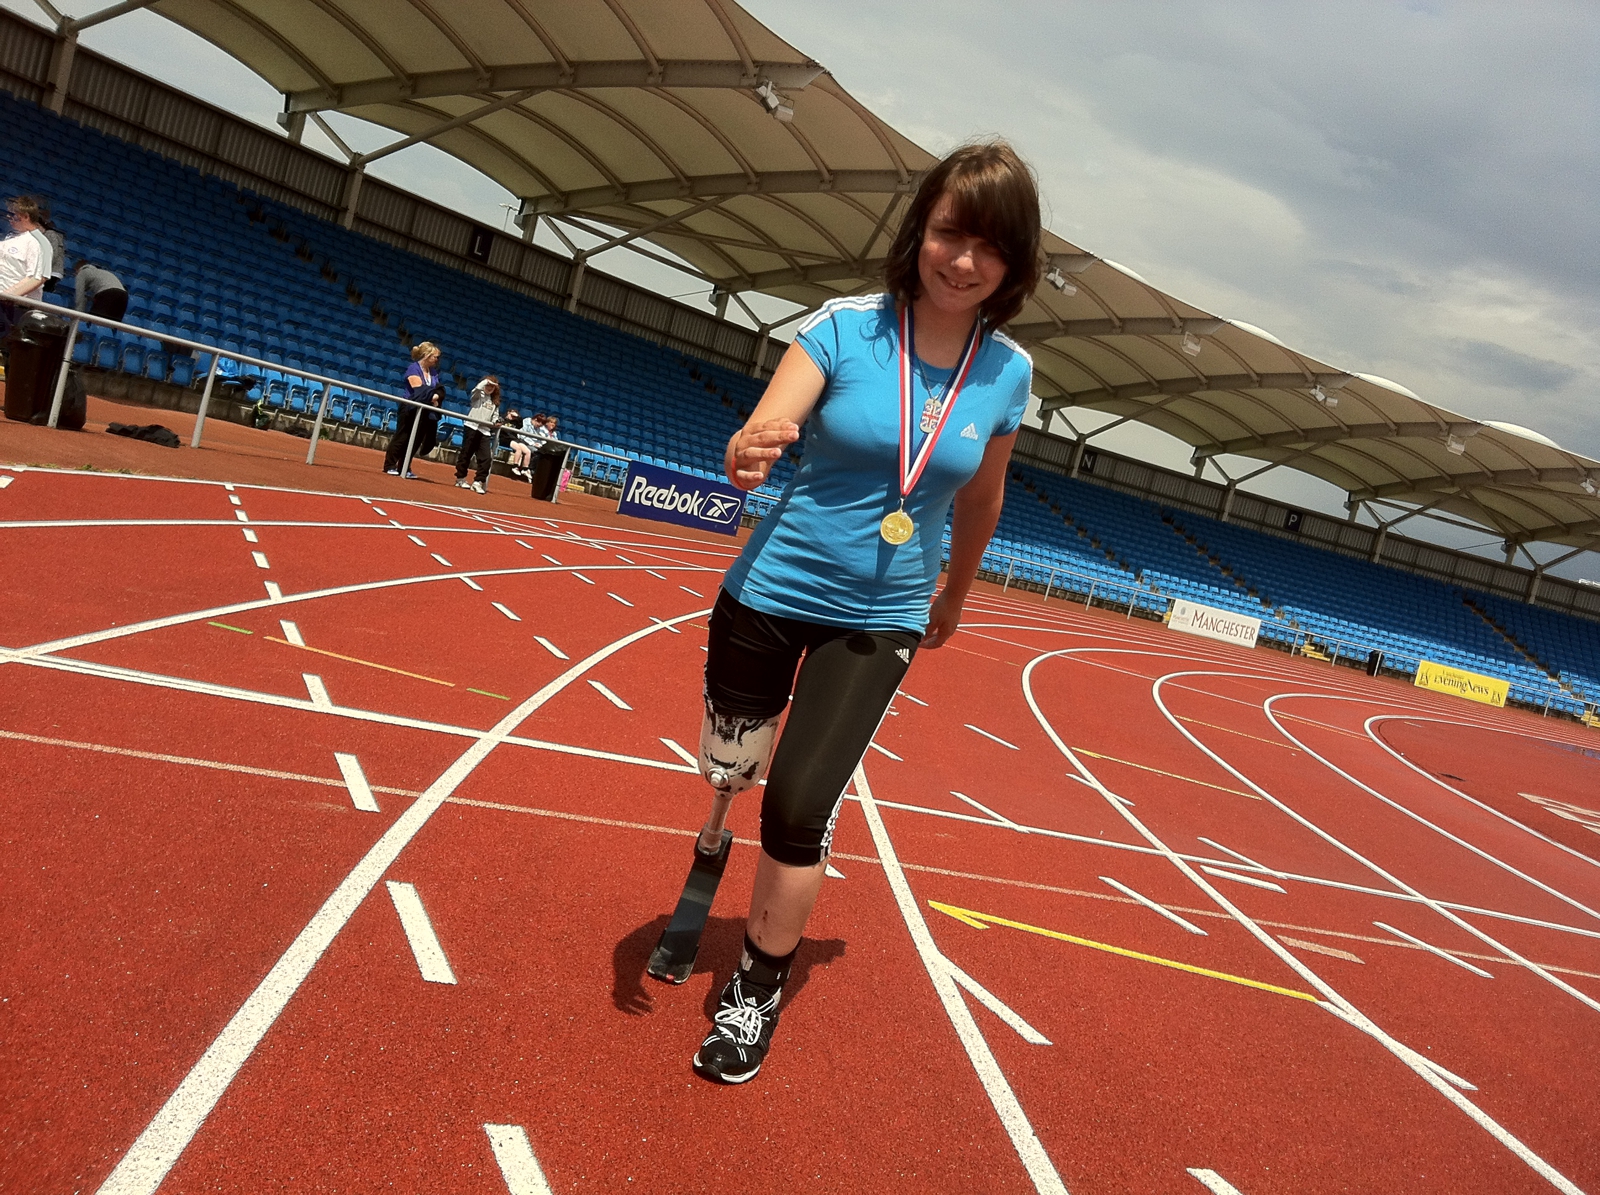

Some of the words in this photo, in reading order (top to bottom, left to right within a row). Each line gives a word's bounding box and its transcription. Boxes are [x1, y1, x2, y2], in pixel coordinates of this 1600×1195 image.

[474, 235, 482, 255] L
[1081, 454, 1094, 469] N
[626, 475, 705, 516] Reebok
[1288, 514, 1298, 526] P
[1190, 609, 1256, 641] MANCHESTER
